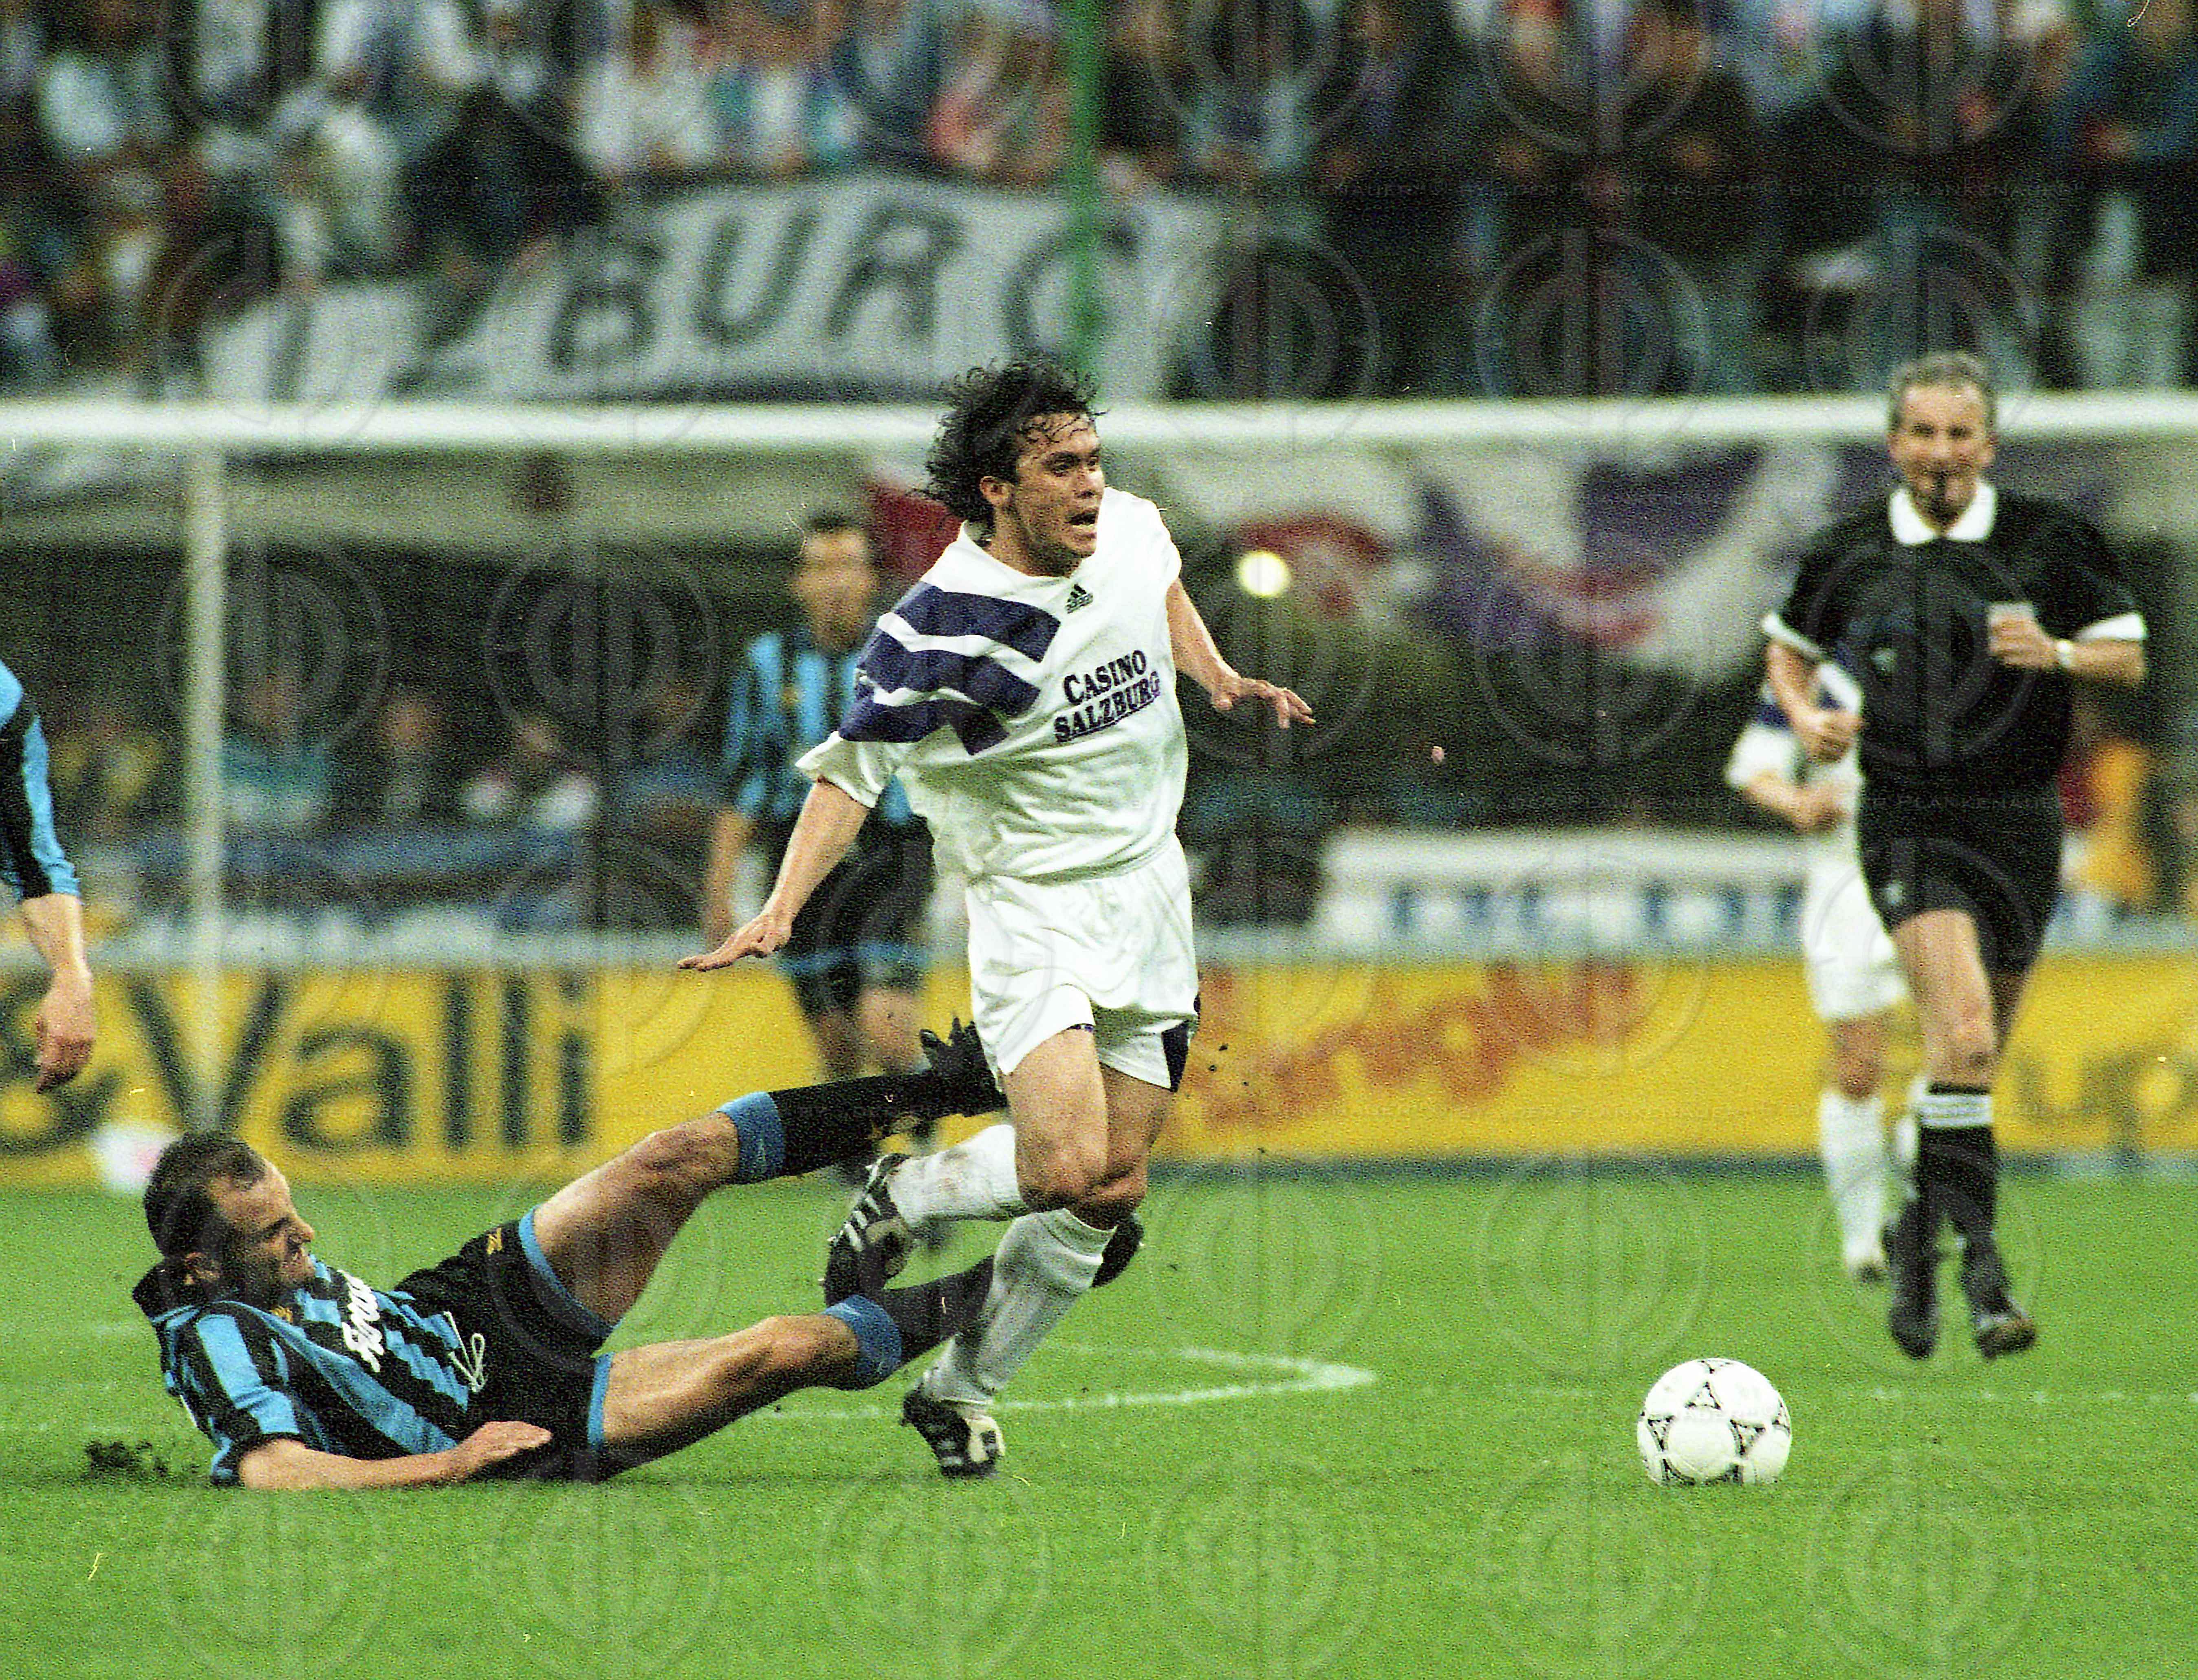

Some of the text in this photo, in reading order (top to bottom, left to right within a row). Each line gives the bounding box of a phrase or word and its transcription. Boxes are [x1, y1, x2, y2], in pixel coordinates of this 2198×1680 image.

[1054, 671, 1161, 742] SALZBURG
[1064, 650, 1147, 706] CASINO
[126, 971, 593, 1147] Valli
